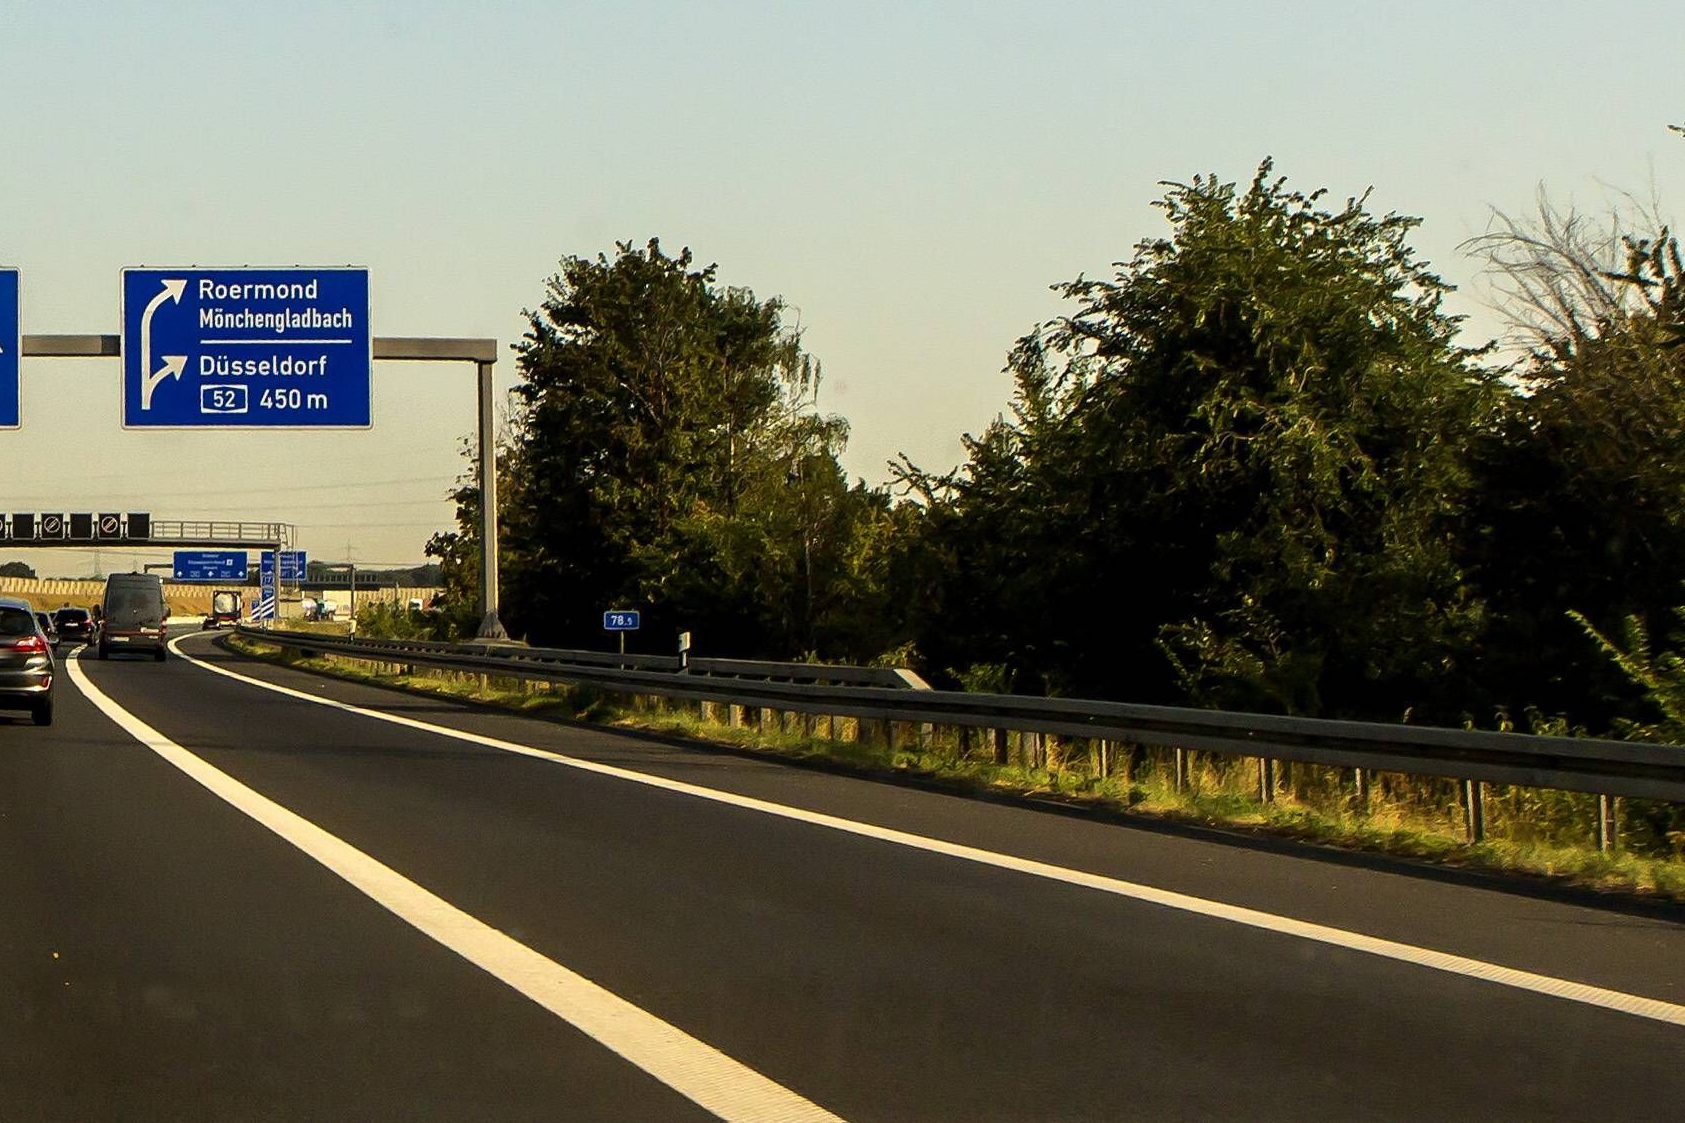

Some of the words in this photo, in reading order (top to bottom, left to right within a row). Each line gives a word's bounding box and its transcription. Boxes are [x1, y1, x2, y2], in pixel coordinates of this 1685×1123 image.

[199, 279, 318, 299] Roermond
[199, 307, 352, 333] Mönchengladbach
[200, 355, 327, 376] Düsseldorf
[212, 390, 236, 408] 52
[259, 389, 301, 409] 450
[307, 394, 328, 409] m
